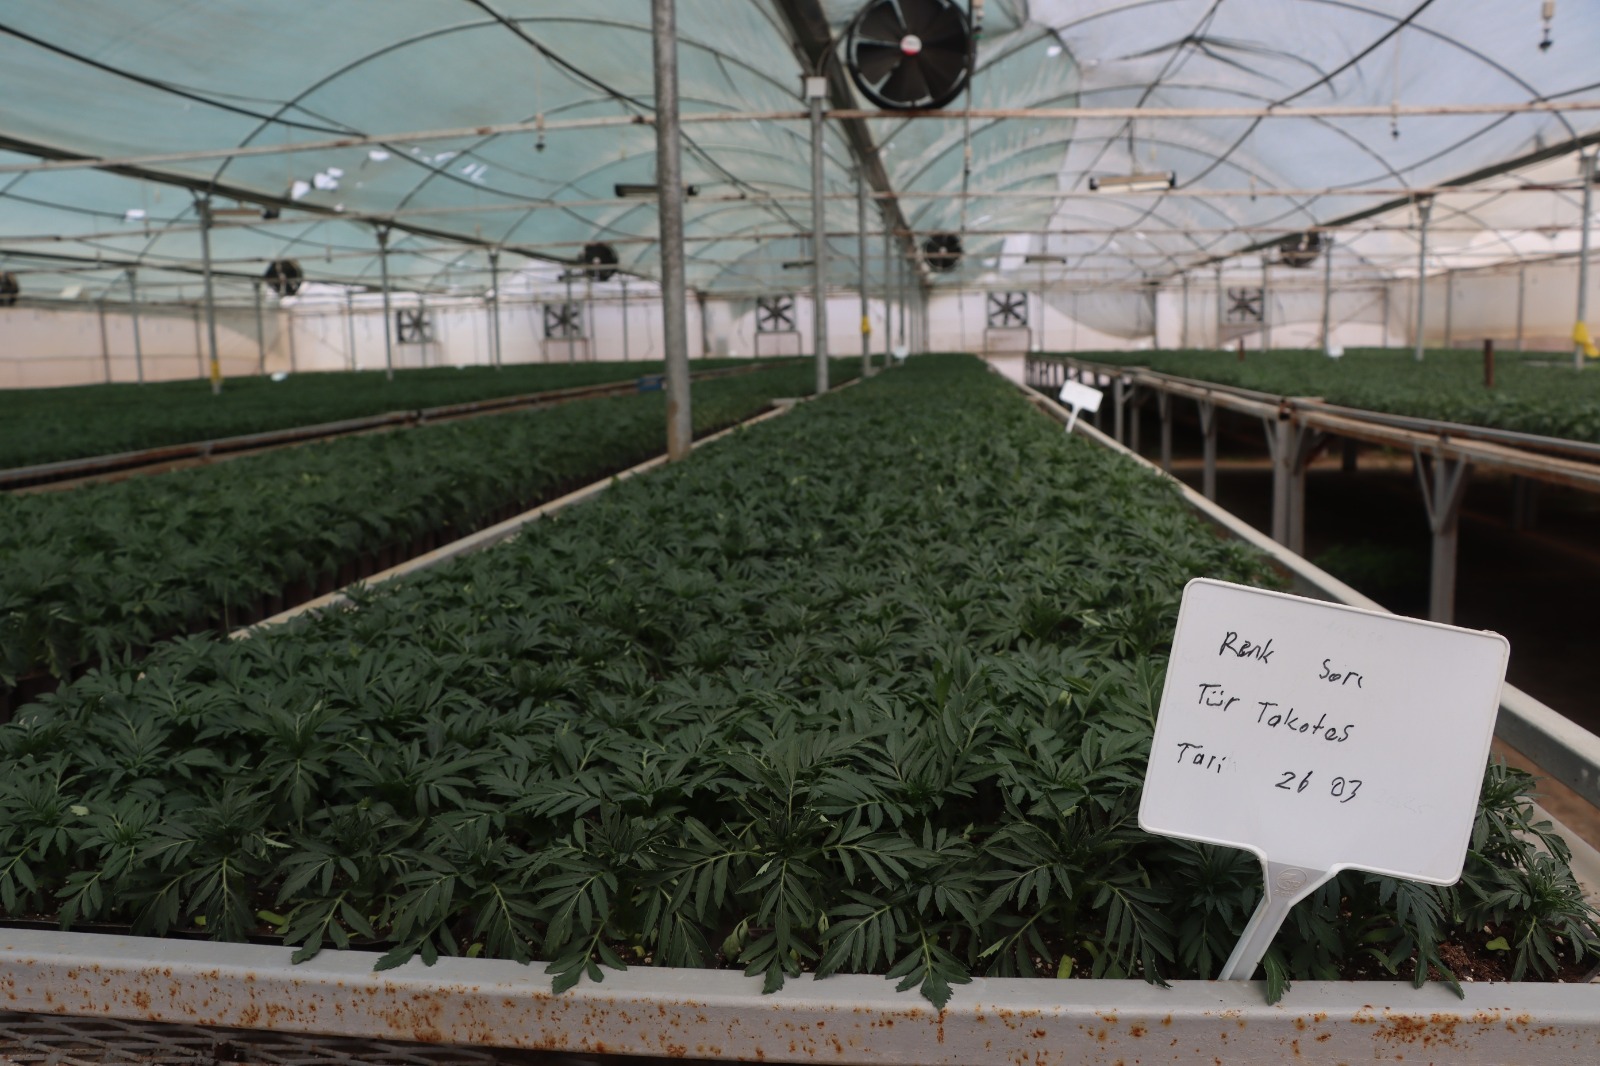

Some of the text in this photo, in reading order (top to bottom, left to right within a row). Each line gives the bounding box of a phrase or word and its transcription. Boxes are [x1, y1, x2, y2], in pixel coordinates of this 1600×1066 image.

[1218, 631, 1275, 665] Renk
[1198, 682, 1241, 712] Tür
[1176, 742, 1237, 774] Tari
[1274, 770, 1314, 794] 26
[1330, 776, 1363, 804] 03
